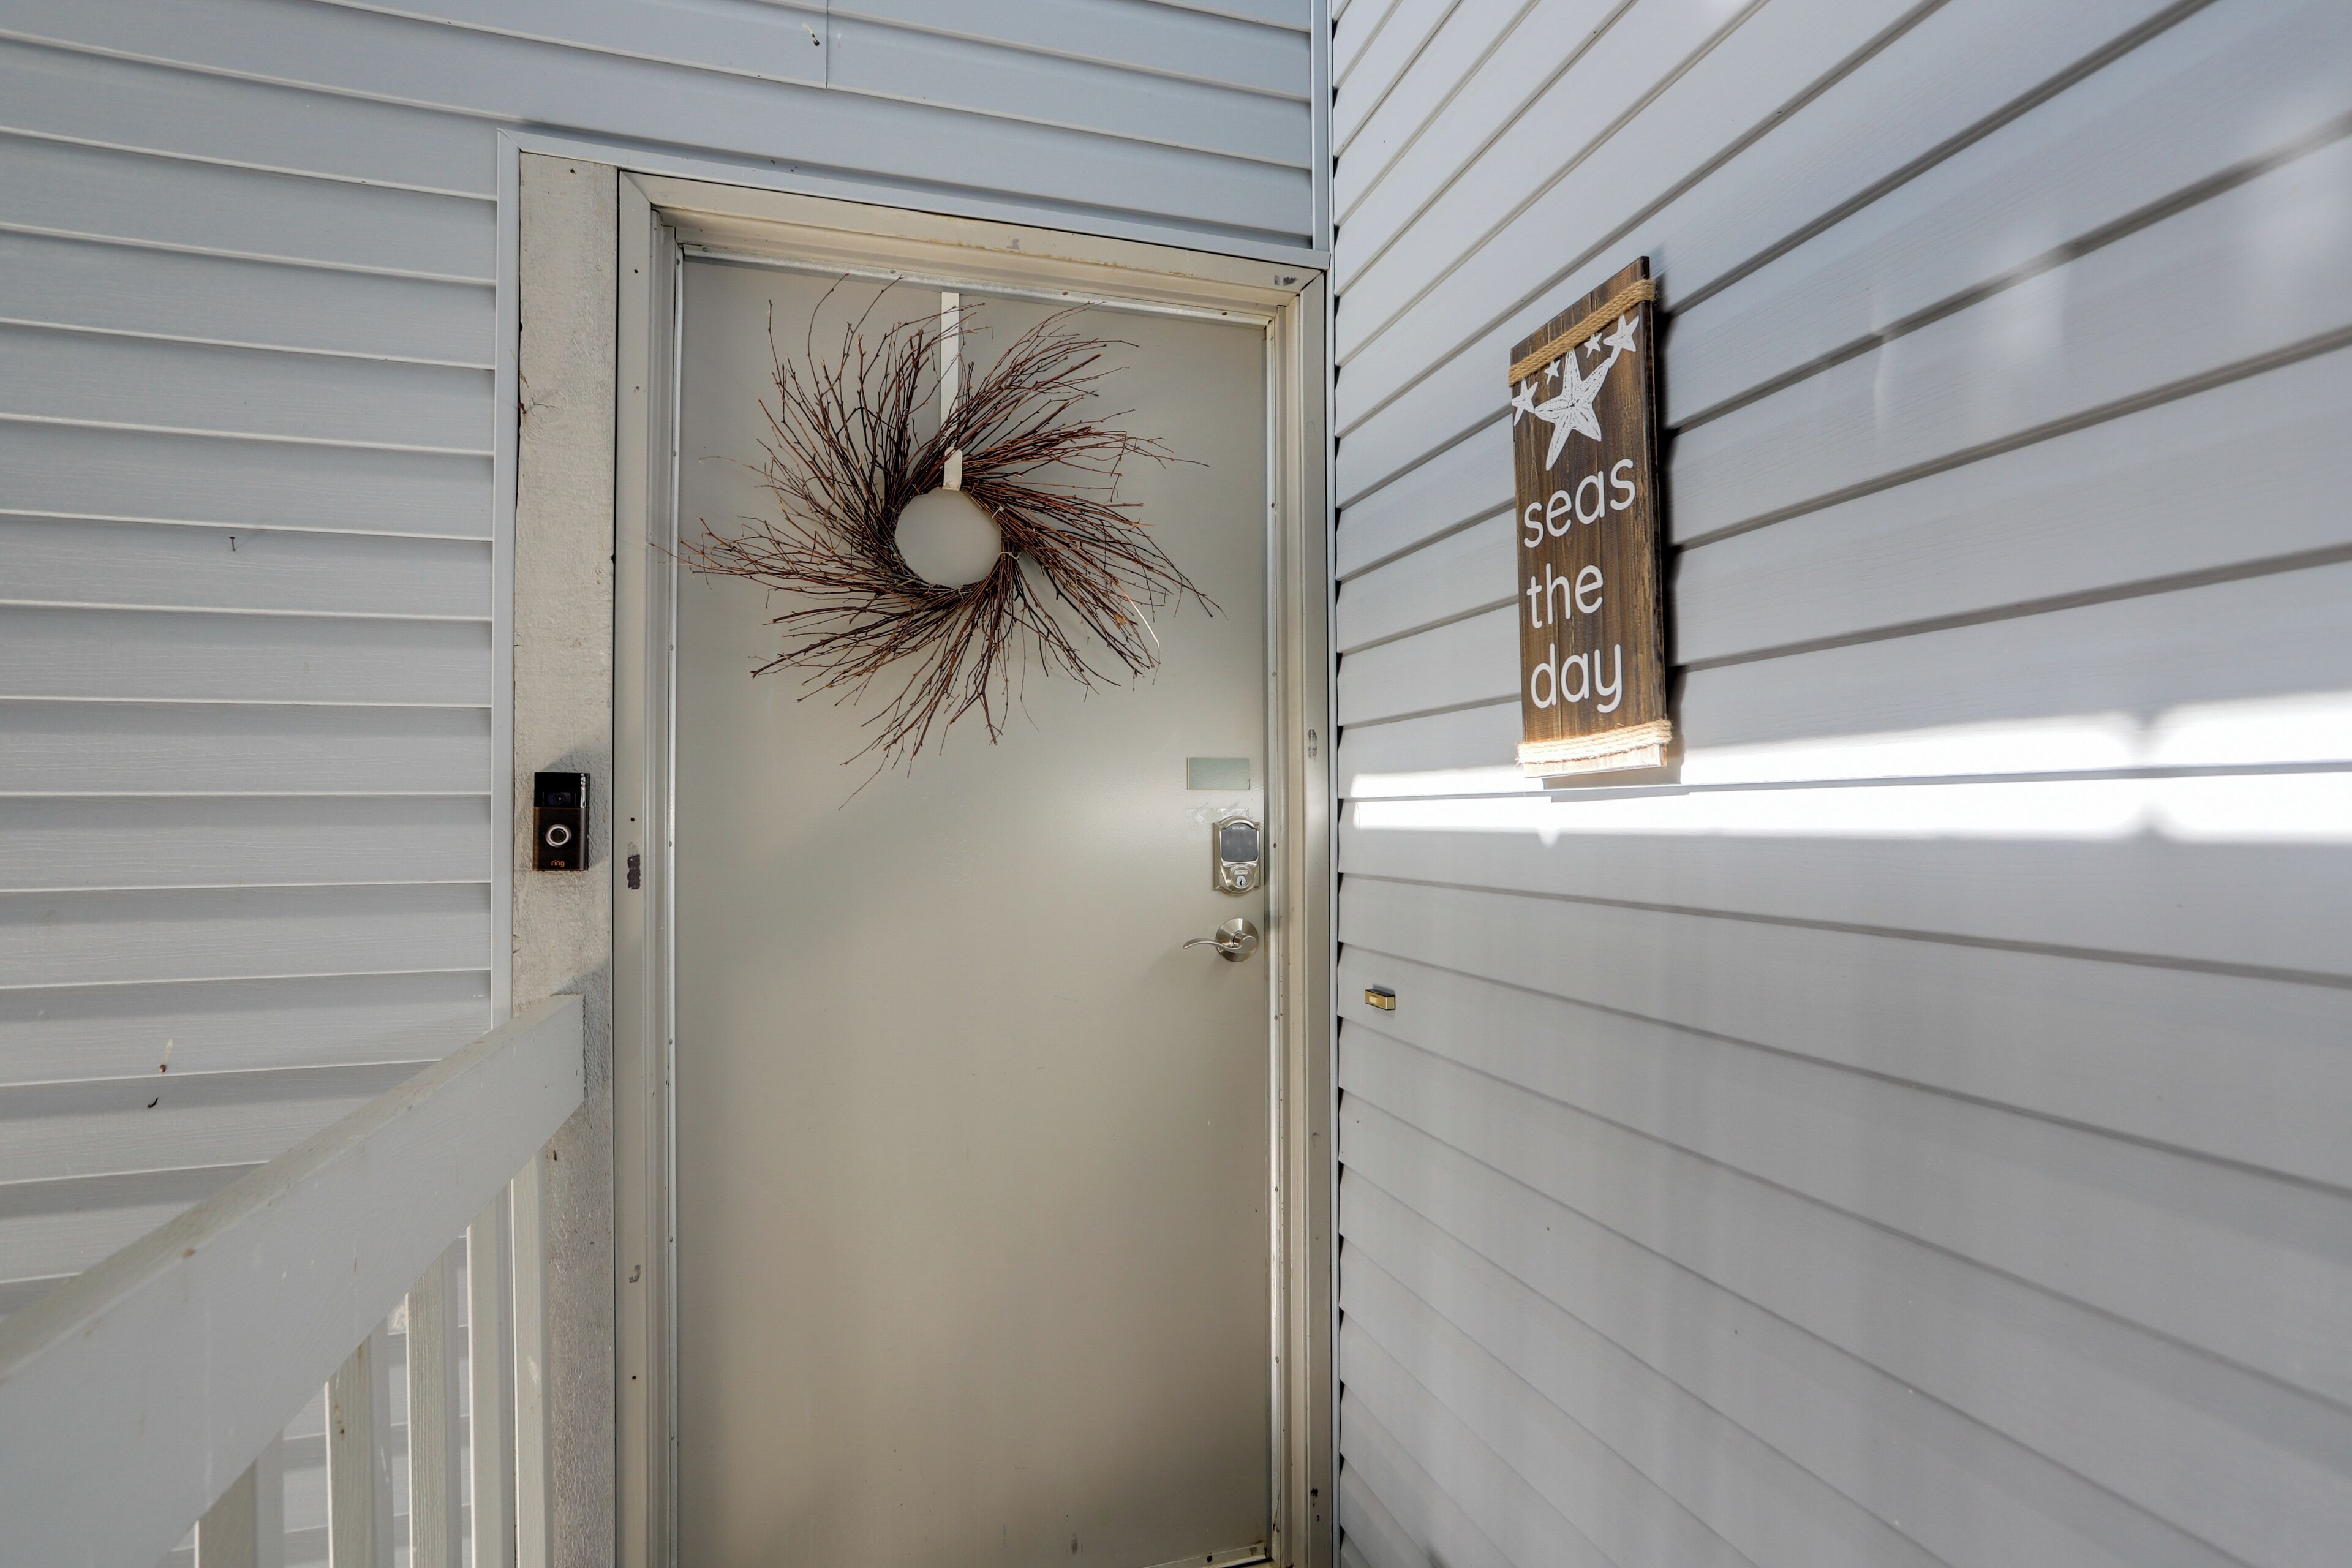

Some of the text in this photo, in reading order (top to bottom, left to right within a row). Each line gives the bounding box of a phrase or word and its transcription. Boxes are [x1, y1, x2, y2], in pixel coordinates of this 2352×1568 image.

[1524, 458, 1636, 548] seas
[1526, 562, 1604, 630] the
[1531, 643, 1623, 714] day
